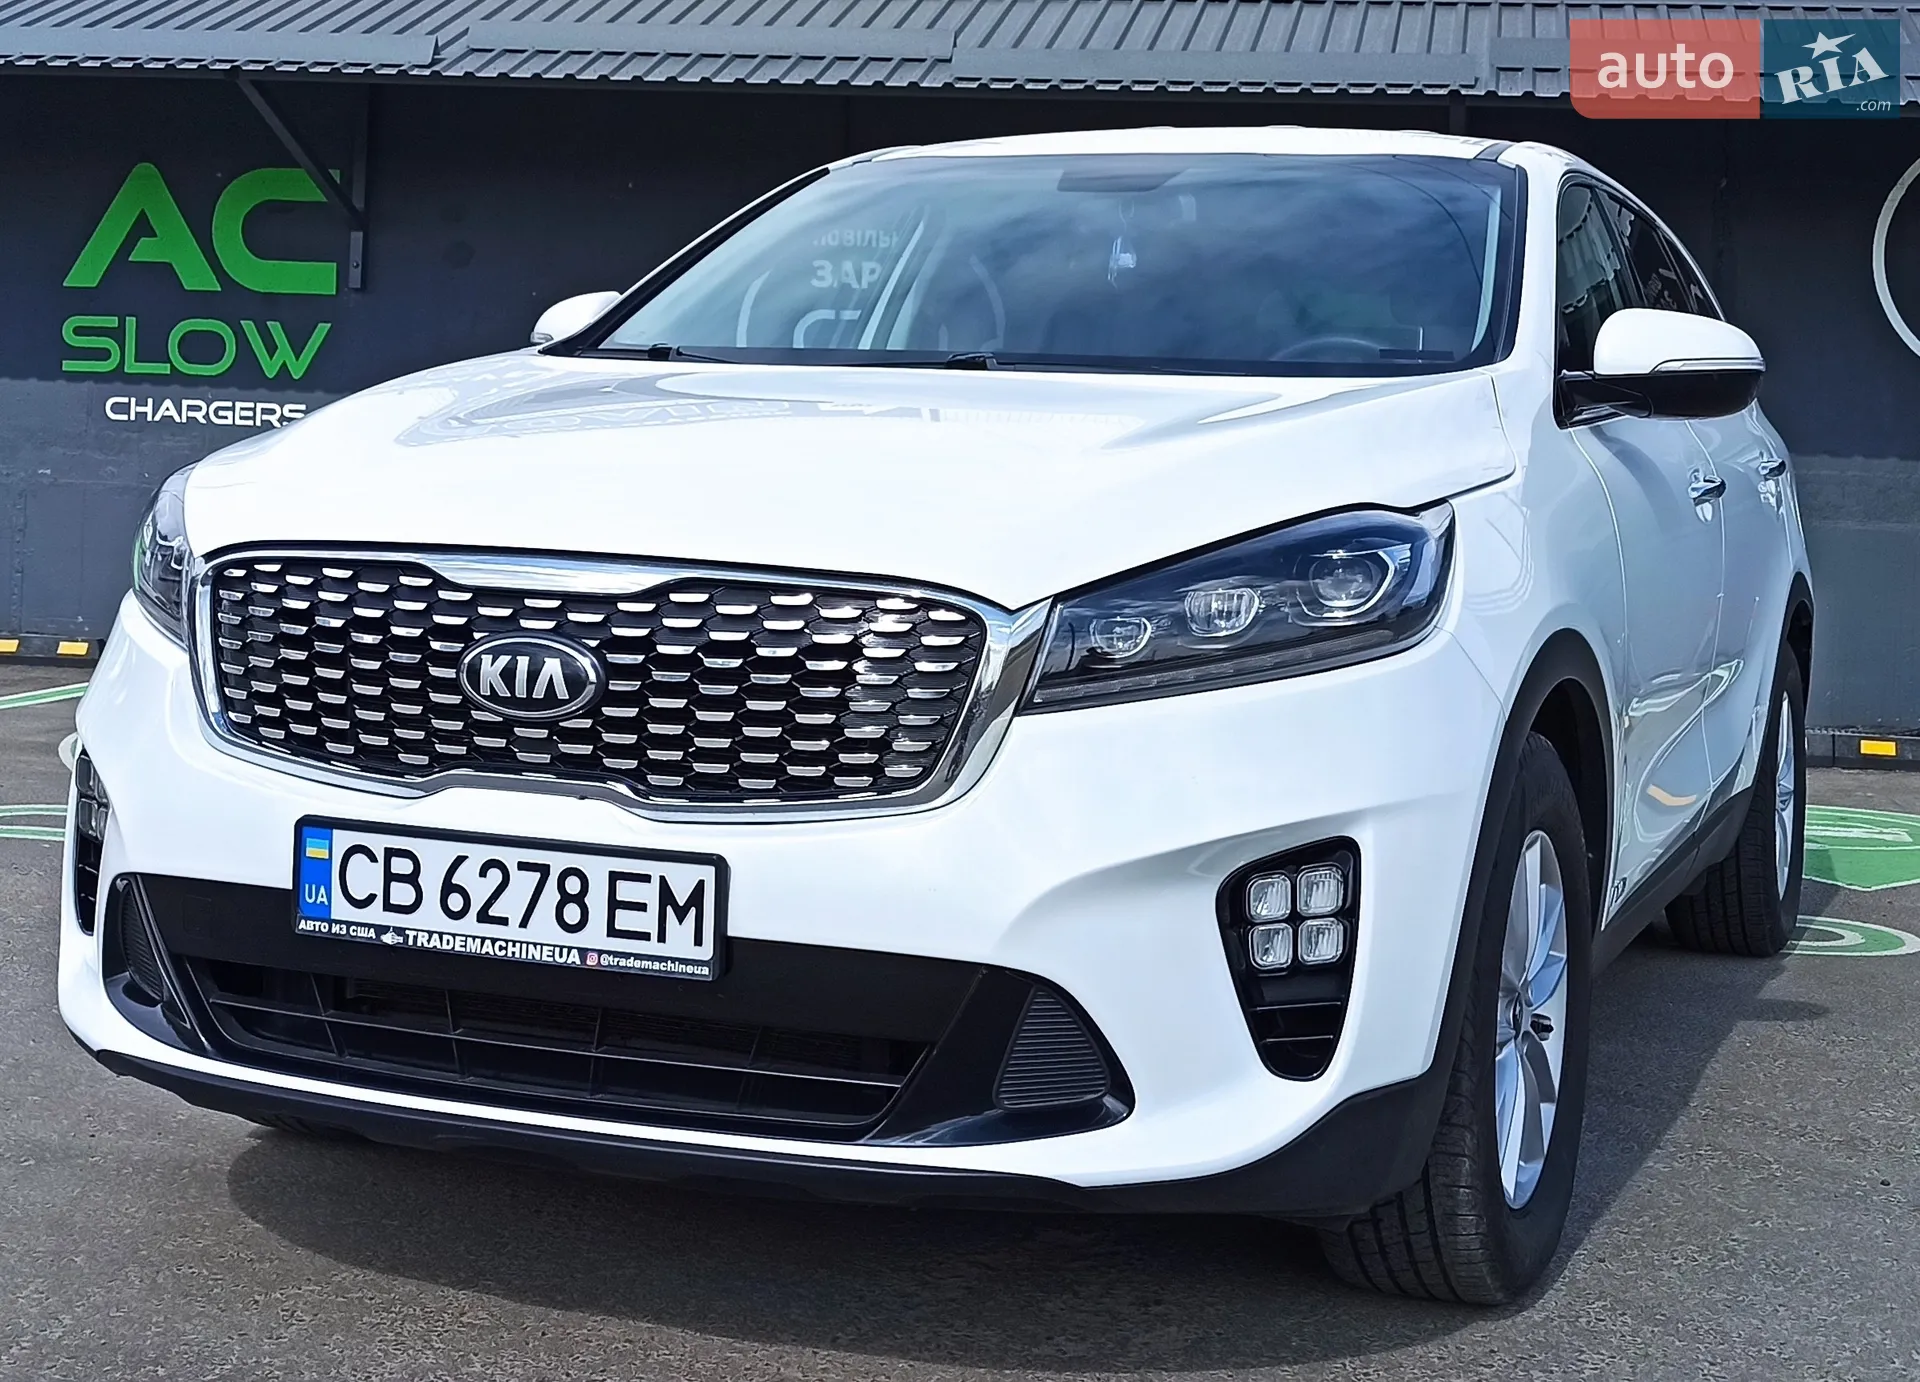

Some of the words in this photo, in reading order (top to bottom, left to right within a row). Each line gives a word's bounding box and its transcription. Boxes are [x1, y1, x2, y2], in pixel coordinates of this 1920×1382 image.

[62, 162, 341, 295] AC
[62, 315, 332, 380] SLOW
[104, 396, 307, 428] CHARGERS
[479, 654, 570, 700] KIA
[304, 882, 329, 906] UA
[338, 844, 424, 915] CB
[439, 855, 590, 934] 6278
[606, 870, 706, 948] EM
[298, 919, 329, 933] АВТО
[331, 923, 347, 935] ИЗ
[349, 925, 376, 939] США
[405, 930, 581, 965] TRADEMACHINEUA
[599, 953, 710, 976] @trademachineua
